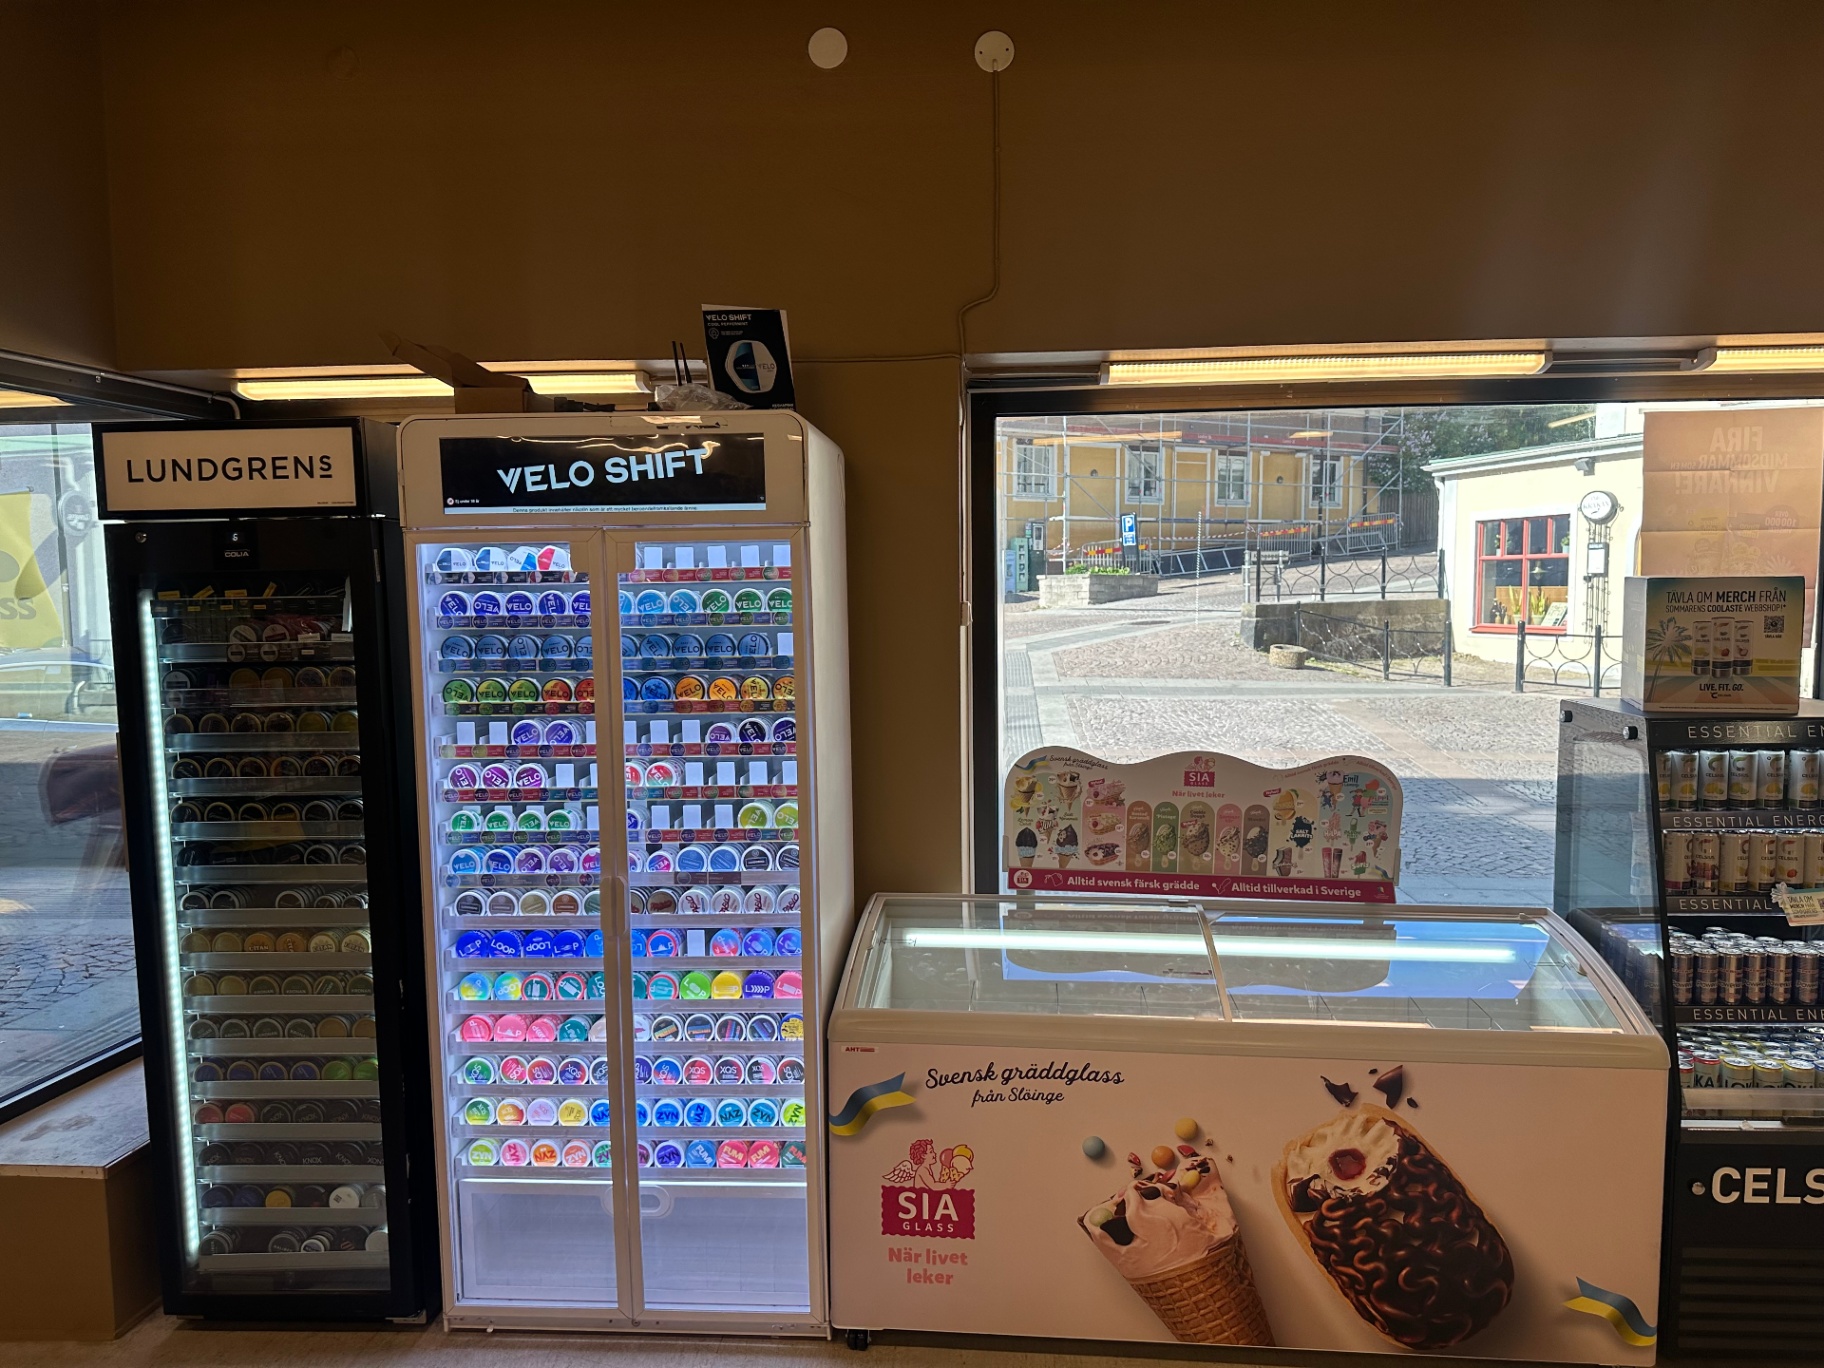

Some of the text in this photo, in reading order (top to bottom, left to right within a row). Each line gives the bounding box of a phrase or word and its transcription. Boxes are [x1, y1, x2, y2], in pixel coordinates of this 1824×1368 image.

[126, 455, 333, 482] LUNDGRENS
[497, 448, 707, 494] VELO SHIFT
[552, 561, 565, 569] VELO
[1666, 587, 1787, 603] TÄVLA OM MERCH FRÅN
[506, 602, 532, 610] VELO
[638, 600, 664, 612] VELO
[704, 595, 727, 613] VELO
[735, 600, 762, 609] VELO
[1665, 604, 1705, 613] SOMMARENS
[1707, 604, 1743, 613] COOLASTE
[445, 644, 469, 657] VELO
[479, 647, 503, 655] VELO
[544, 645, 568, 655] VELO
[707, 645, 733, 653] VELO
[678, 684, 702, 698] VELO
[1700, 683, 1717, 691] LIVE.
[1718, 683, 1731, 691] FIT.
[478, 690, 504, 698] VELO
[510, 690, 536, 698] VELO
[543, 690, 569, 698] VELO
[709, 732, 731, 740] VELO
[1687, 725, 1797, 739] ESSENTIAL
[516, 772, 541, 786] VELO
[1189, 772, 1210, 782] SIA
[1172, 790, 1186, 798] När
[487, 820, 508, 828] VELO
[548, 820, 570, 828] VELO
[1673, 815, 1765, 828] ESSENTIAL
[454, 861, 476, 869] VELO
[1067, 876, 1200, 891] Alltid svensk färsk grädde
[1231, 882, 1261, 893] Alltid
[1262, 883, 1314, 895] tillverkad
[1320, 886, 1361, 899] Sverige
[1679, 899, 1773, 910] ESSENTIAL
[490, 939, 516, 955] LOOP
[526, 941, 551, 952] LOOP
[1693, 1008, 1787, 1020] ESSENTIAL
[566, 1064, 582, 1078] XQS
[688, 1066, 706, 1074] XQS
[720, 1066, 737, 1074] XQS
[925, 1061, 1125, 1089] Svensk gräddglass
[971, 1087, 1065, 1108] från Slöinge
[657, 1112, 679, 1120] ZYN
[752, 1108, 774, 1122] ZYN
[471, 1151, 493, 1160] ZYN
[566, 1151, 587, 1164] ZYN
[658, 1150, 680, 1164] ZYN
[695, 1145, 713, 1165] FUMI
[723, 1145, 744, 1161] FUMI
[751, 1145, 770, 1162] FUMI
[898, 1191, 959, 1222] SIA
[902, 1221, 954, 1233] GLASS
[888, 1247, 969, 1266] När livet
[906, 1268, 954, 1285] leker
